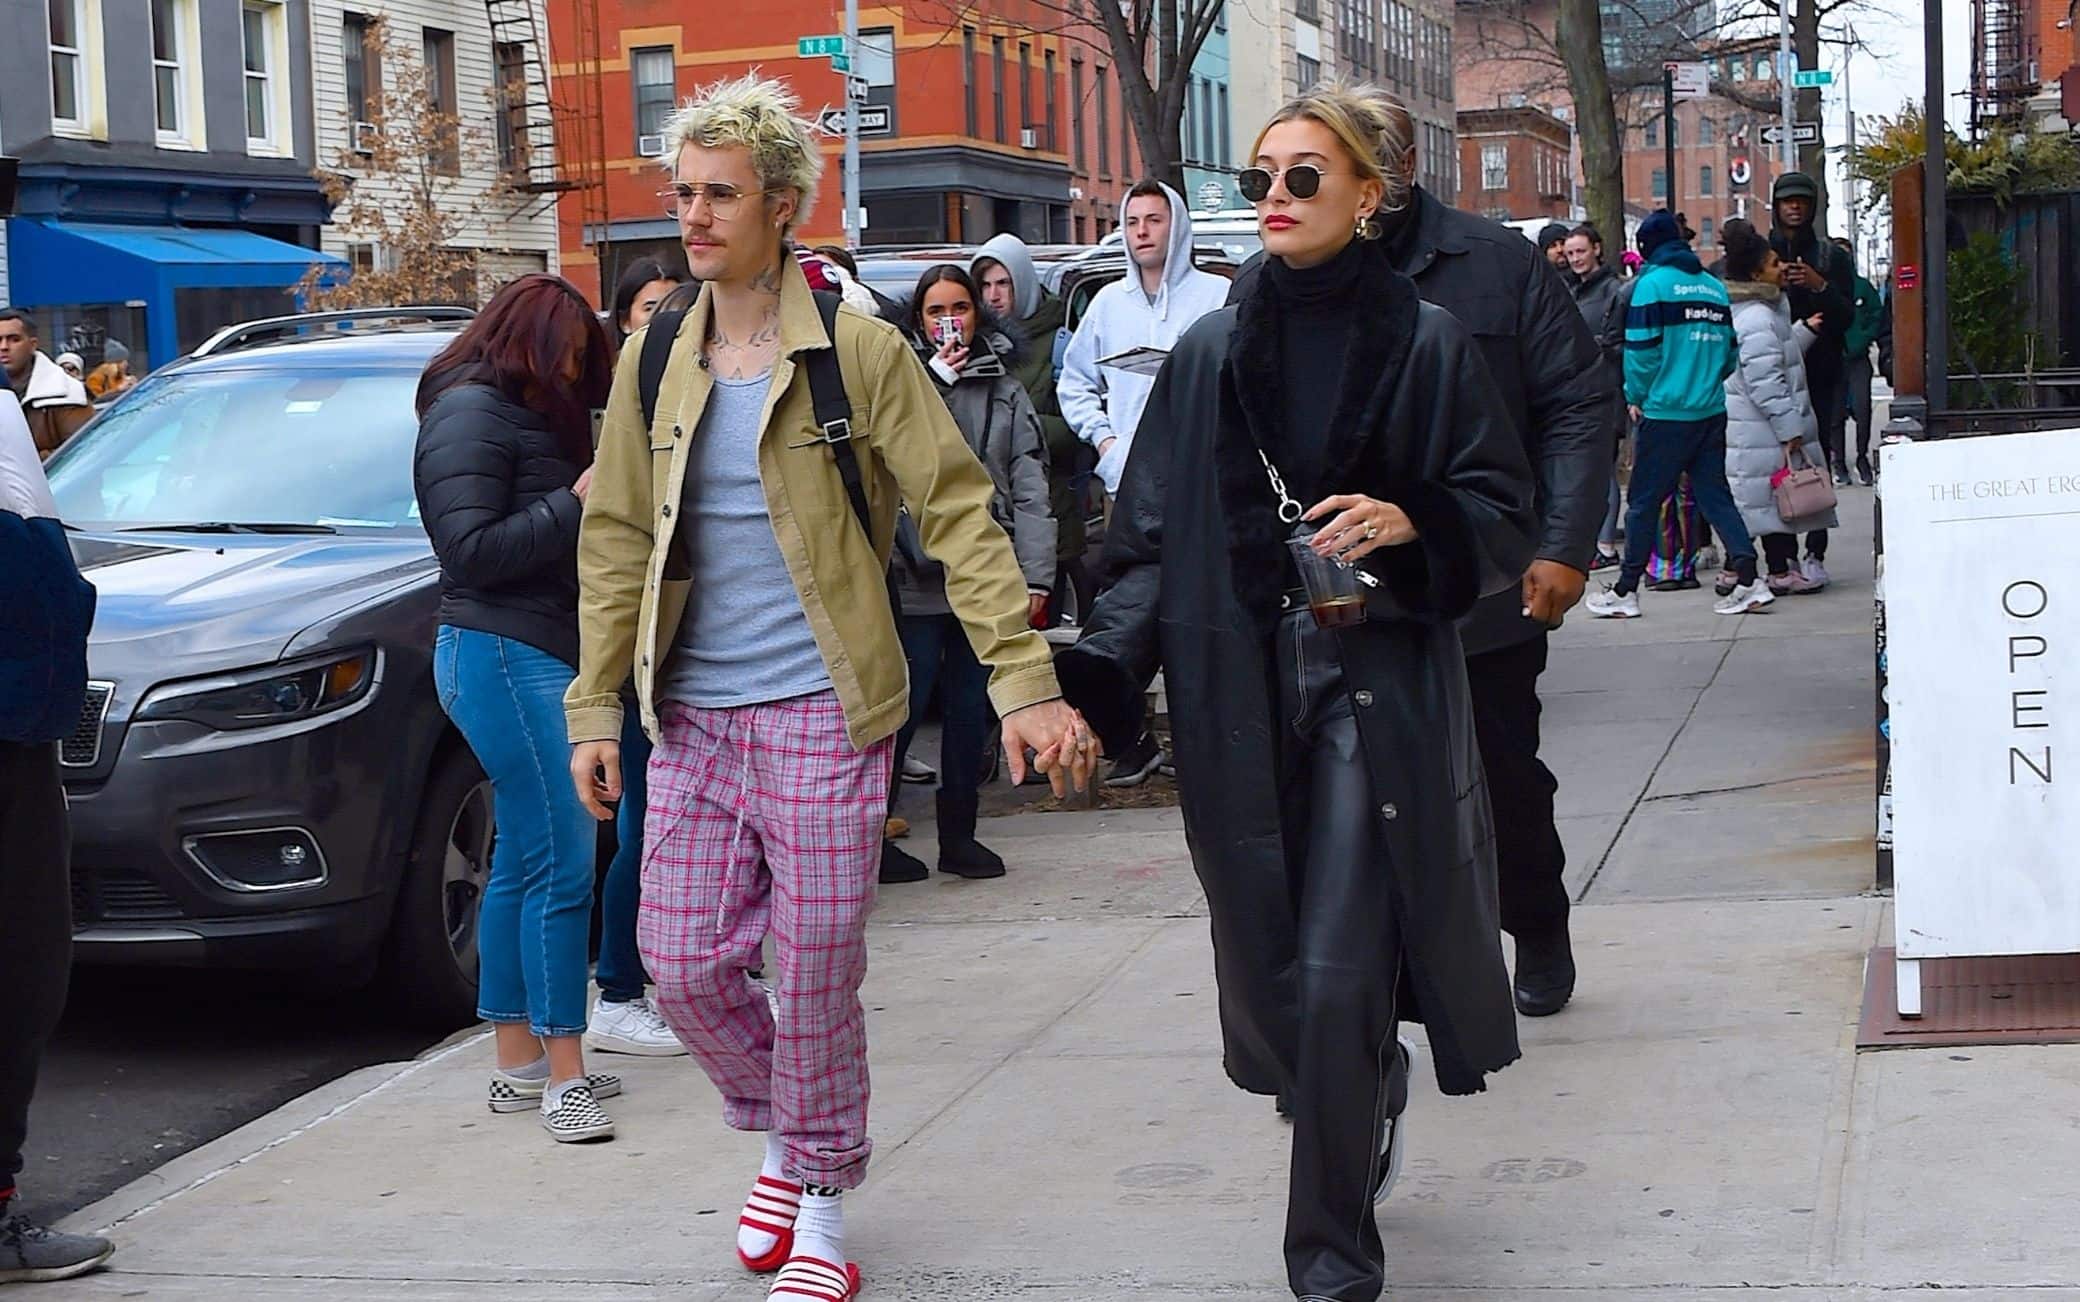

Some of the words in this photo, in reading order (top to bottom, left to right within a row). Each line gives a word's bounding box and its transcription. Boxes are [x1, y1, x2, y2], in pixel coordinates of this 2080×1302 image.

[860, 115, 881, 125] WAY
[1928, 483, 1968, 501] THE
[1973, 477, 2040, 498] GREAT
[2002, 580, 2052, 784] OPEN
